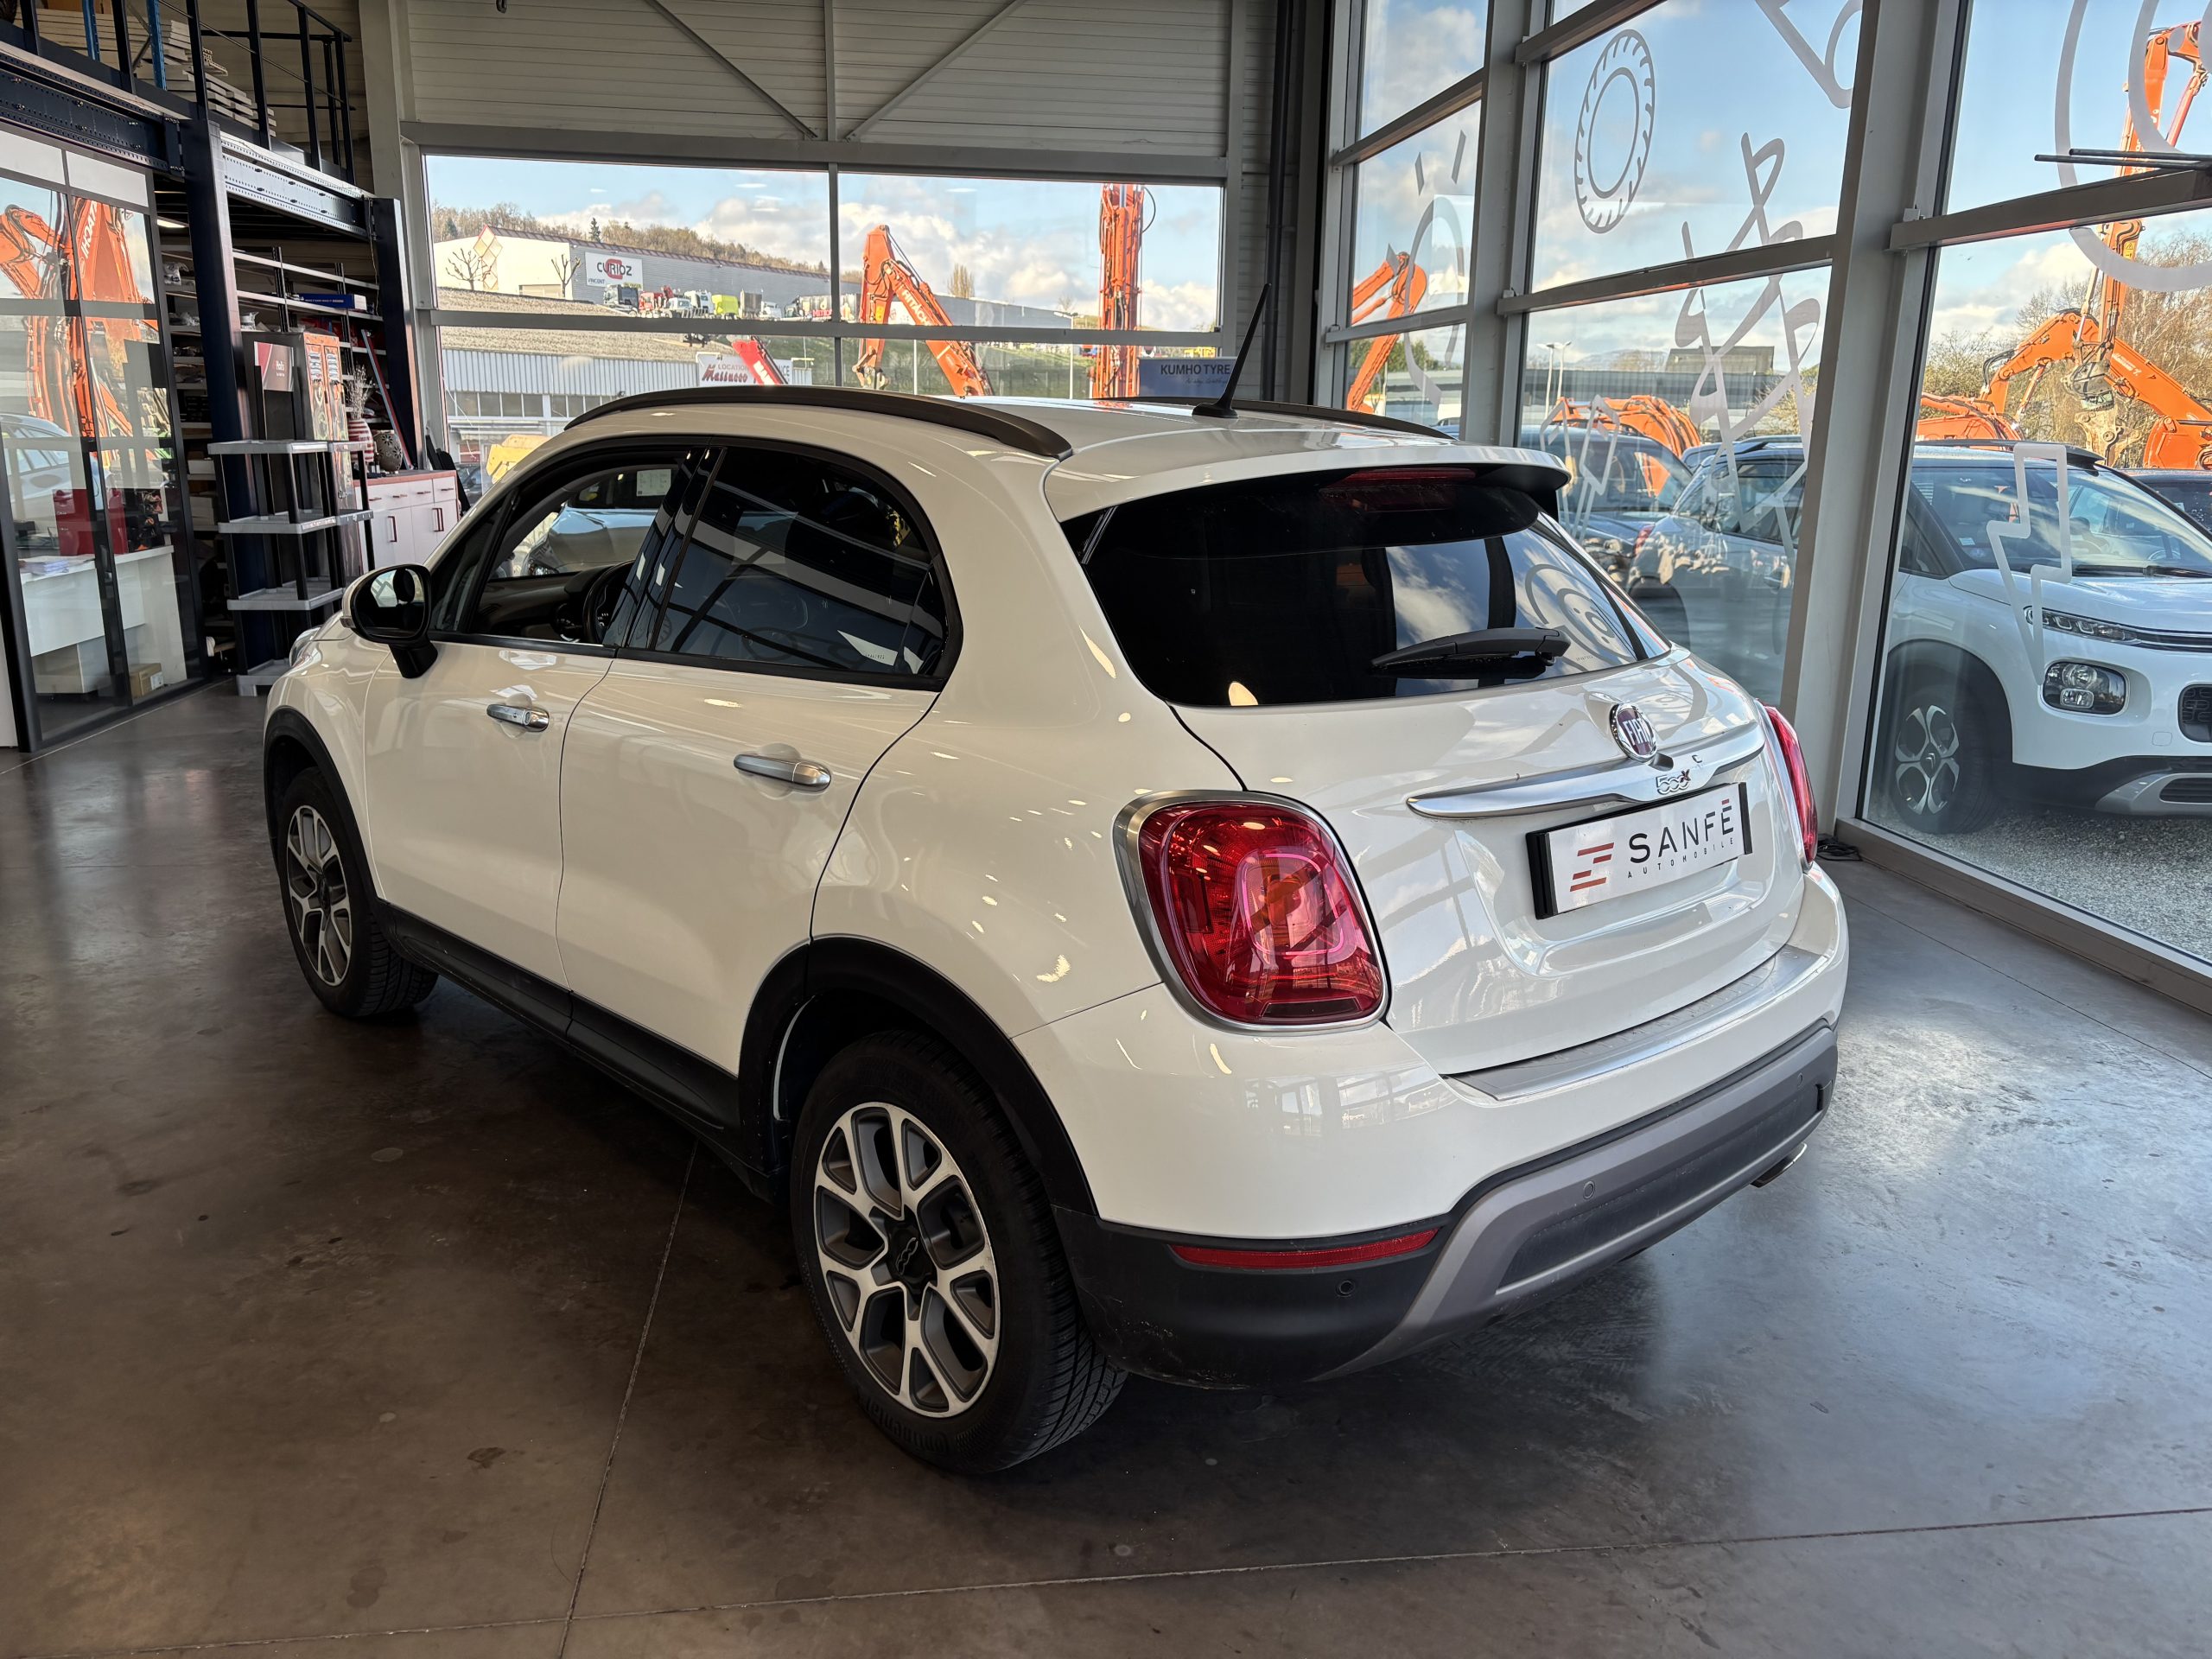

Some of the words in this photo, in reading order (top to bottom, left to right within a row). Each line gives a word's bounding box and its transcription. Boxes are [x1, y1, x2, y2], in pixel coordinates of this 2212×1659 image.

[1160, 364, 1202, 375] KUMHO
[1204, 364, 1230, 375] TYRE
[1623, 718, 1651, 746] FIAT
[1628, 837, 1733, 878] AUTOMOBILE
